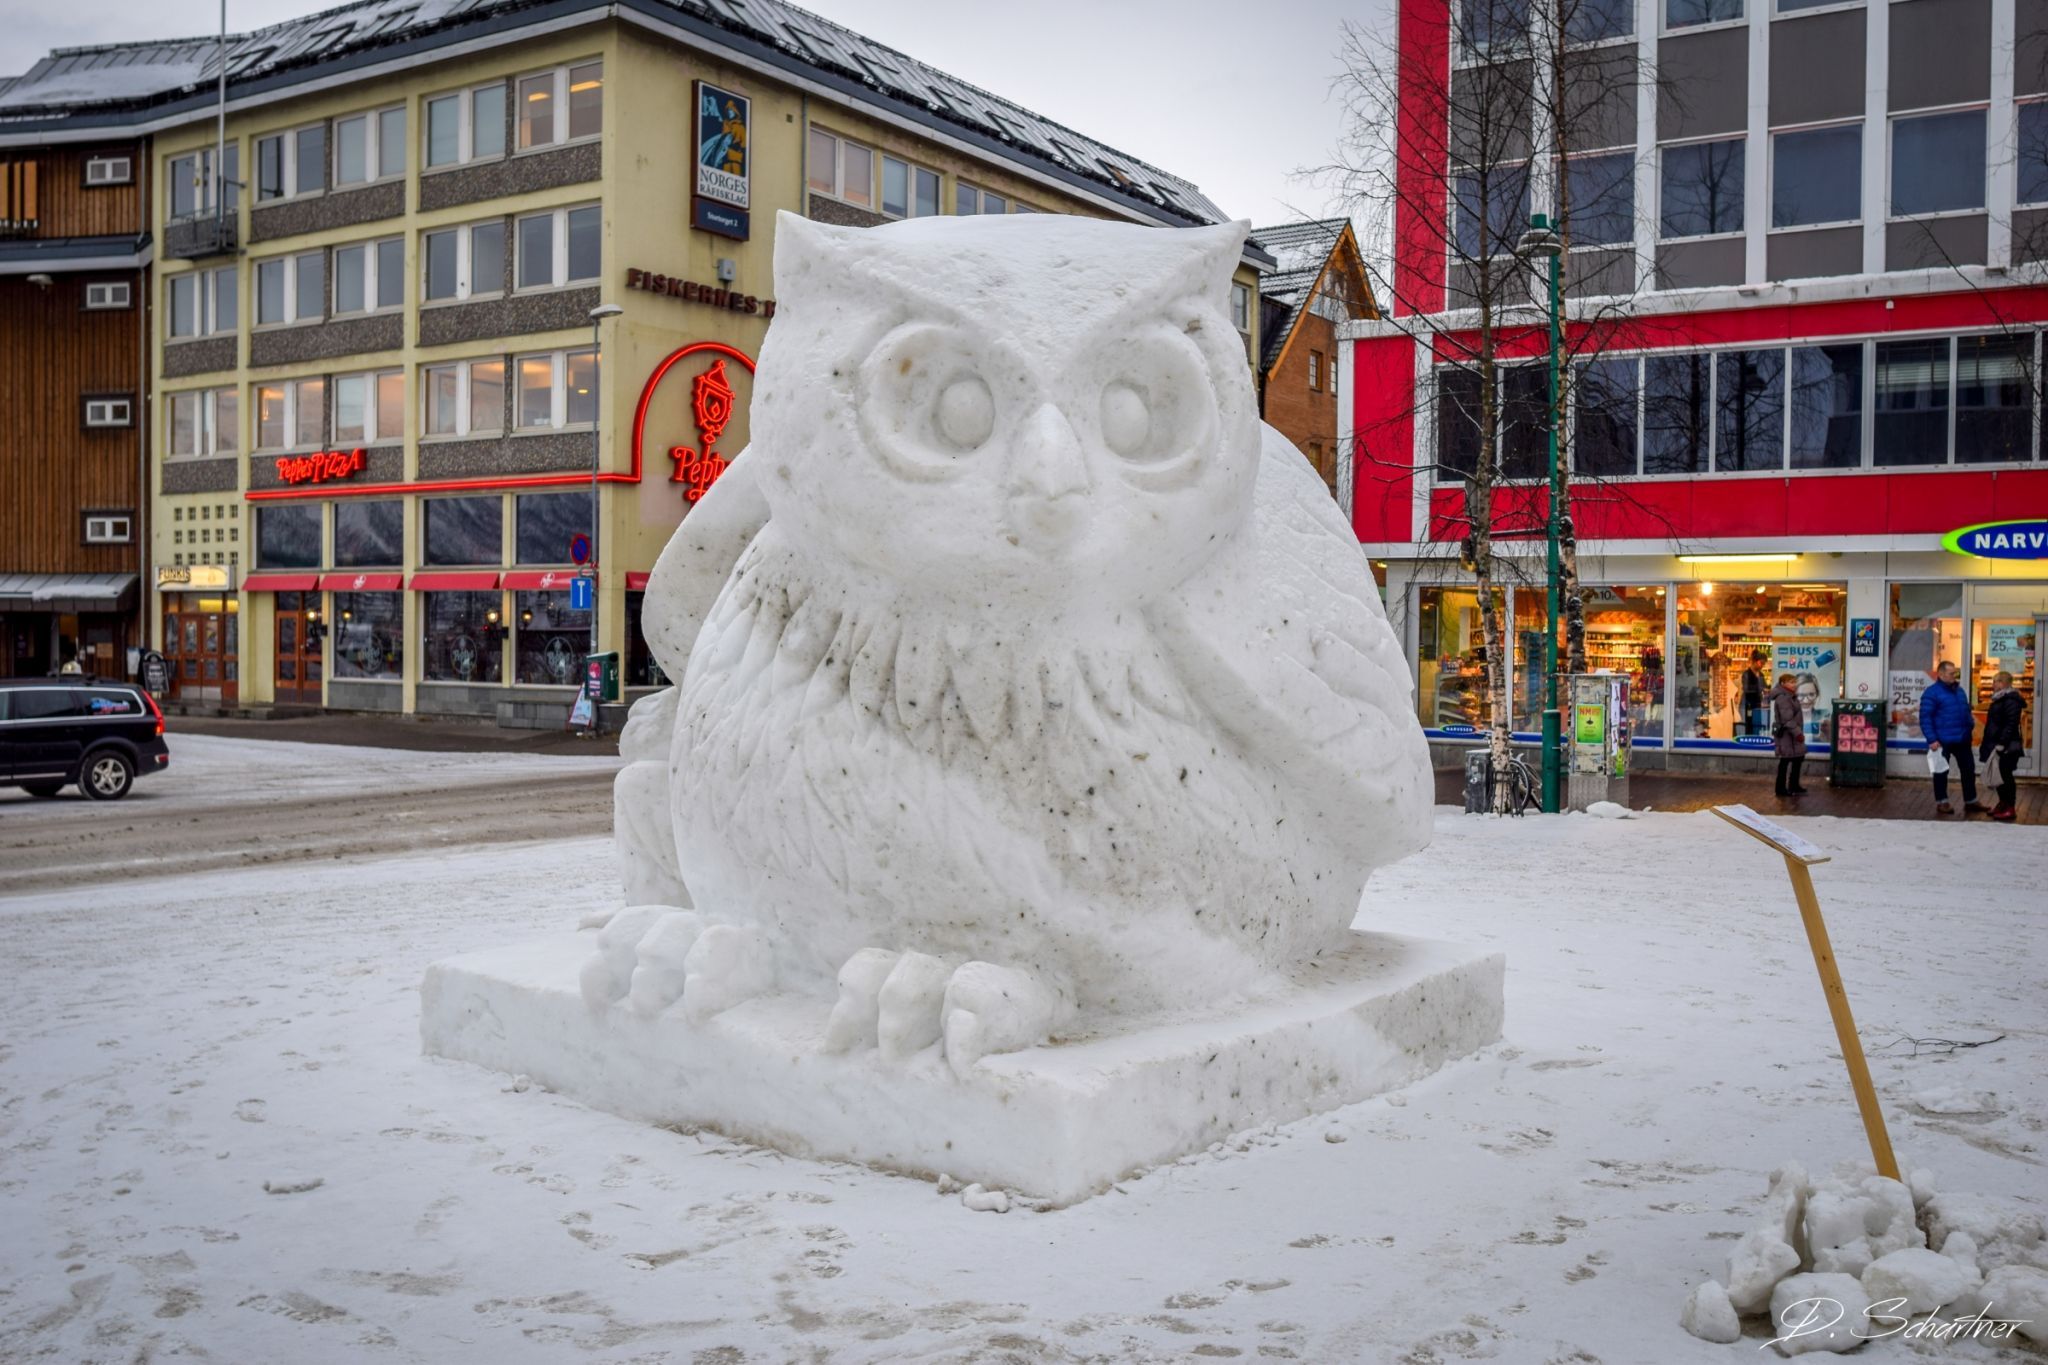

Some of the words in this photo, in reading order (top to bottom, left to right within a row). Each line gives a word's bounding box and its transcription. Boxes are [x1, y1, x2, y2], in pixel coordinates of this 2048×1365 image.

[700, 168, 747, 194] NORGES
[700, 183, 747, 205] RÅFISKLAG
[625, 267, 758, 314] FISKERNES
[311, 447, 362, 484] PIZZA
[668, 446, 731, 493] Pepp
[1974, 532, 2048, 550] NARV
[158, 566, 191, 581] FUNKIS
[1789, 646, 1819, 656] BUSS
[1855, 646, 1874, 654] HER!
[1788, 658, 1811, 669] BÅT
[1892, 676, 1912, 684] Kaffe
[1892, 684, 1926, 692] bakervar
